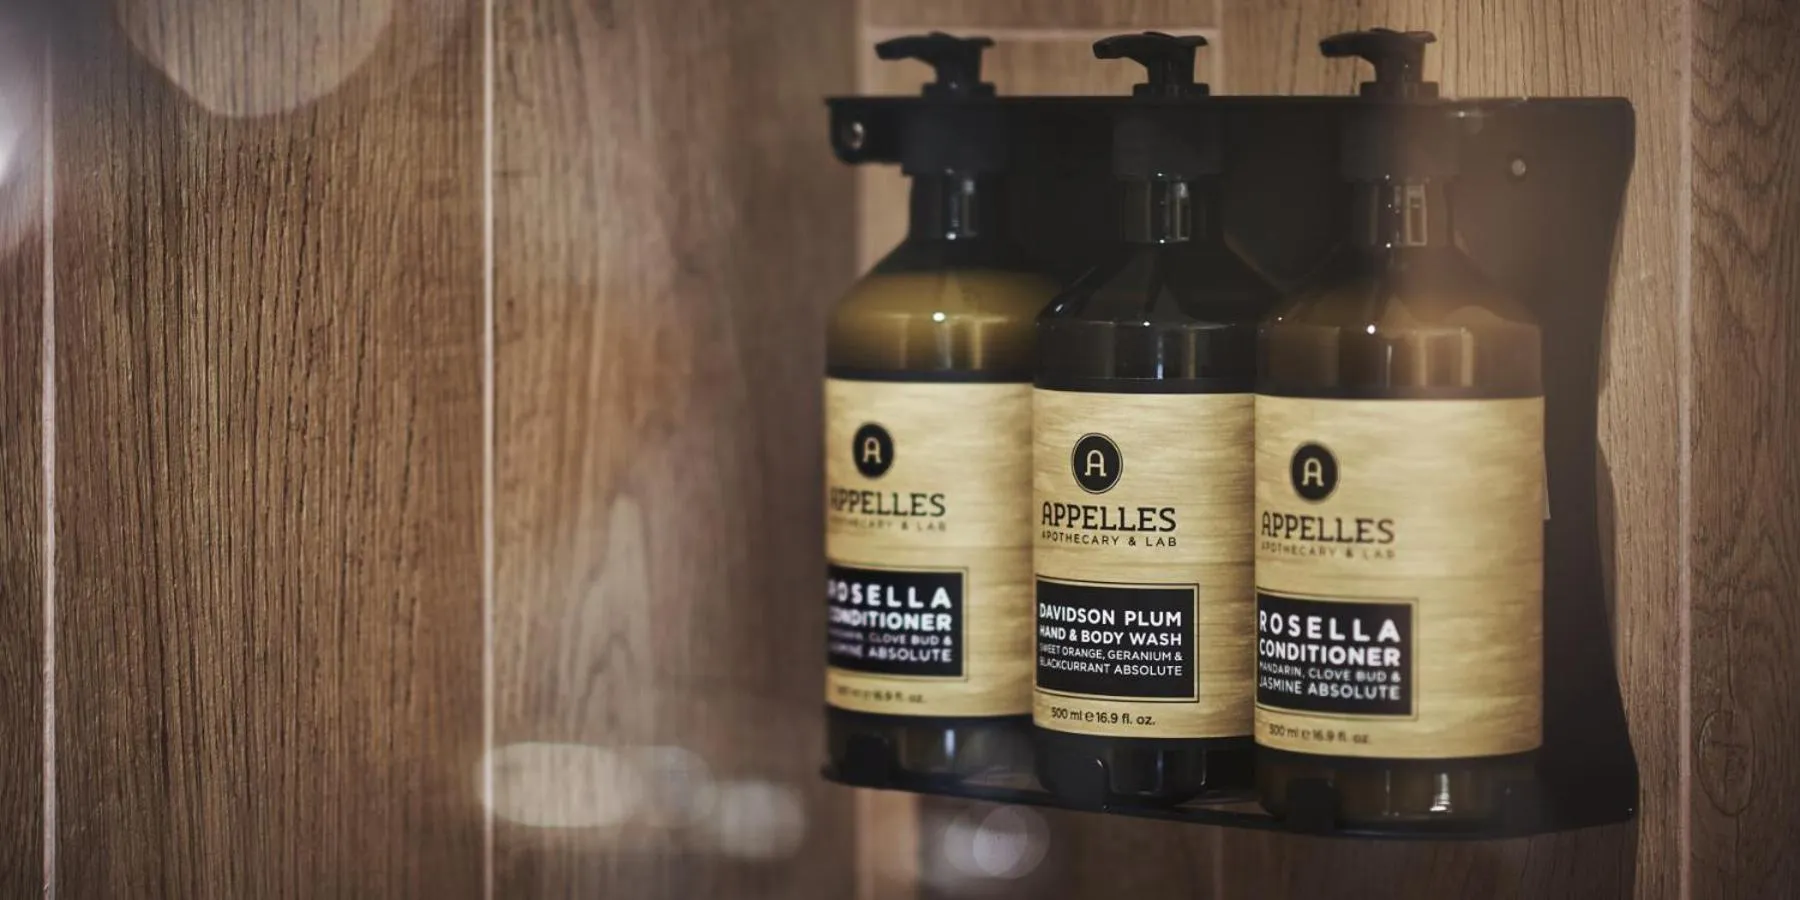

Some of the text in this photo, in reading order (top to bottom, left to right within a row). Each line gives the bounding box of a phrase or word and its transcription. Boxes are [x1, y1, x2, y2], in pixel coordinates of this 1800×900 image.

[863, 437, 882, 464] A
[1085, 449, 1107, 477] A
[1302, 457, 1324, 487] A
[1041, 501, 1177, 532] APPELLES
[1261, 510, 1395, 544] APPELLES
[1042, 531, 1177, 547] APOTHECARY & LAB
[829, 605, 952, 632] DITIONER
[1039, 603, 1182, 627] DAVIDSON PLUM
[1259, 609, 1401, 643] ROSELLA
[1039, 624, 1182, 646] HAND & BODY WASH
[868, 646, 953, 663] ABSOLUTE
[1062, 646, 1105, 661] ORANGE,
[1107, 650, 1171, 661] GERANIUM
[1174, 651, 1182, 661] &
[1259, 638, 1401, 667] CONDITIONER
[1039, 656, 1182, 677] BLACKCURRANT ABSOLUTE
[1308, 668, 1351, 681] CLOVE
[1355, 669, 1387, 682] BUD
[1391, 671, 1401, 683] &
[1259, 676, 1401, 700] JASMINE ABSOLUTE
[1051, 707, 1068, 720] 500
[1070, 709, 1082, 721] ml
[1121, 713, 1133, 725] fl.
[1136, 716, 1156, 726] oz.
[1338, 731, 1349, 742] fl
